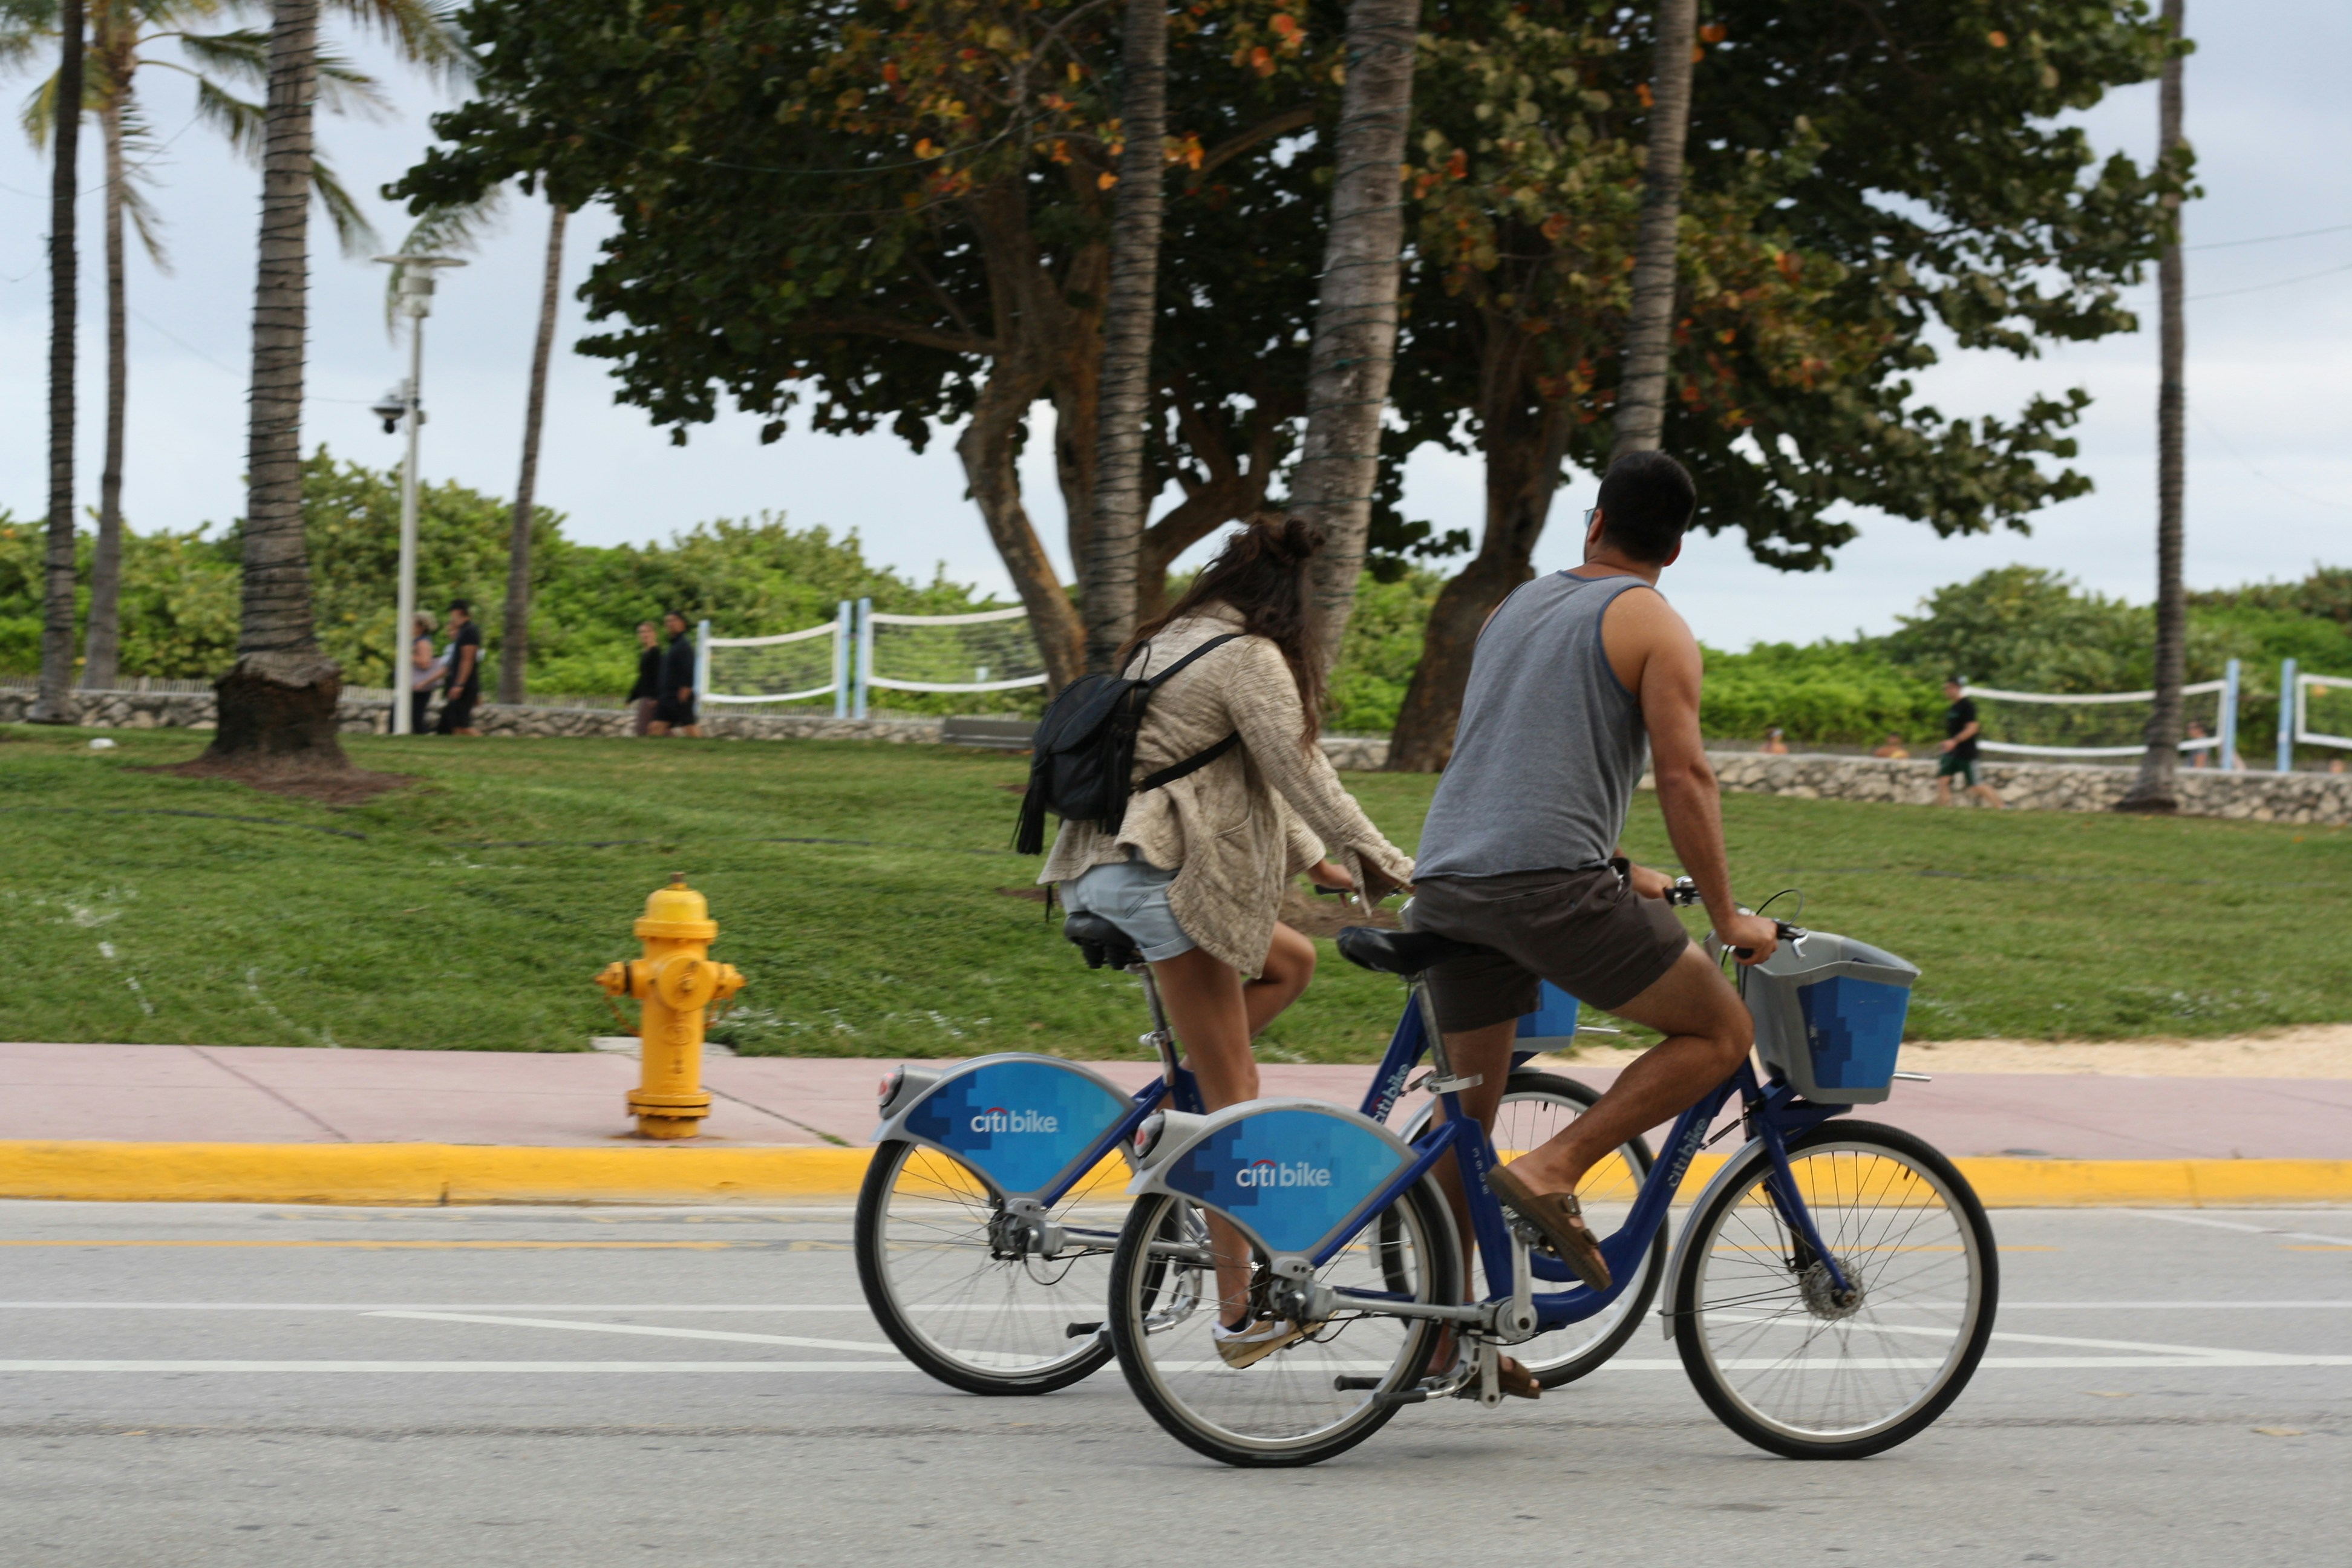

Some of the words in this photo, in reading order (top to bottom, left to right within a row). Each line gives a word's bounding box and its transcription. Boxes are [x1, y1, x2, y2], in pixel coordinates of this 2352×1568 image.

[1382, 1063, 1410, 1099] bike
[970, 1106, 1007, 1132] citi
[1010, 1109, 1058, 1132] bike
[1677, 1119, 1707, 1155] bike
[1236, 1159, 1276, 1187] citi
[1279, 1161, 1331, 1187] bike
[1668, 1157, 1688, 1187] citi
